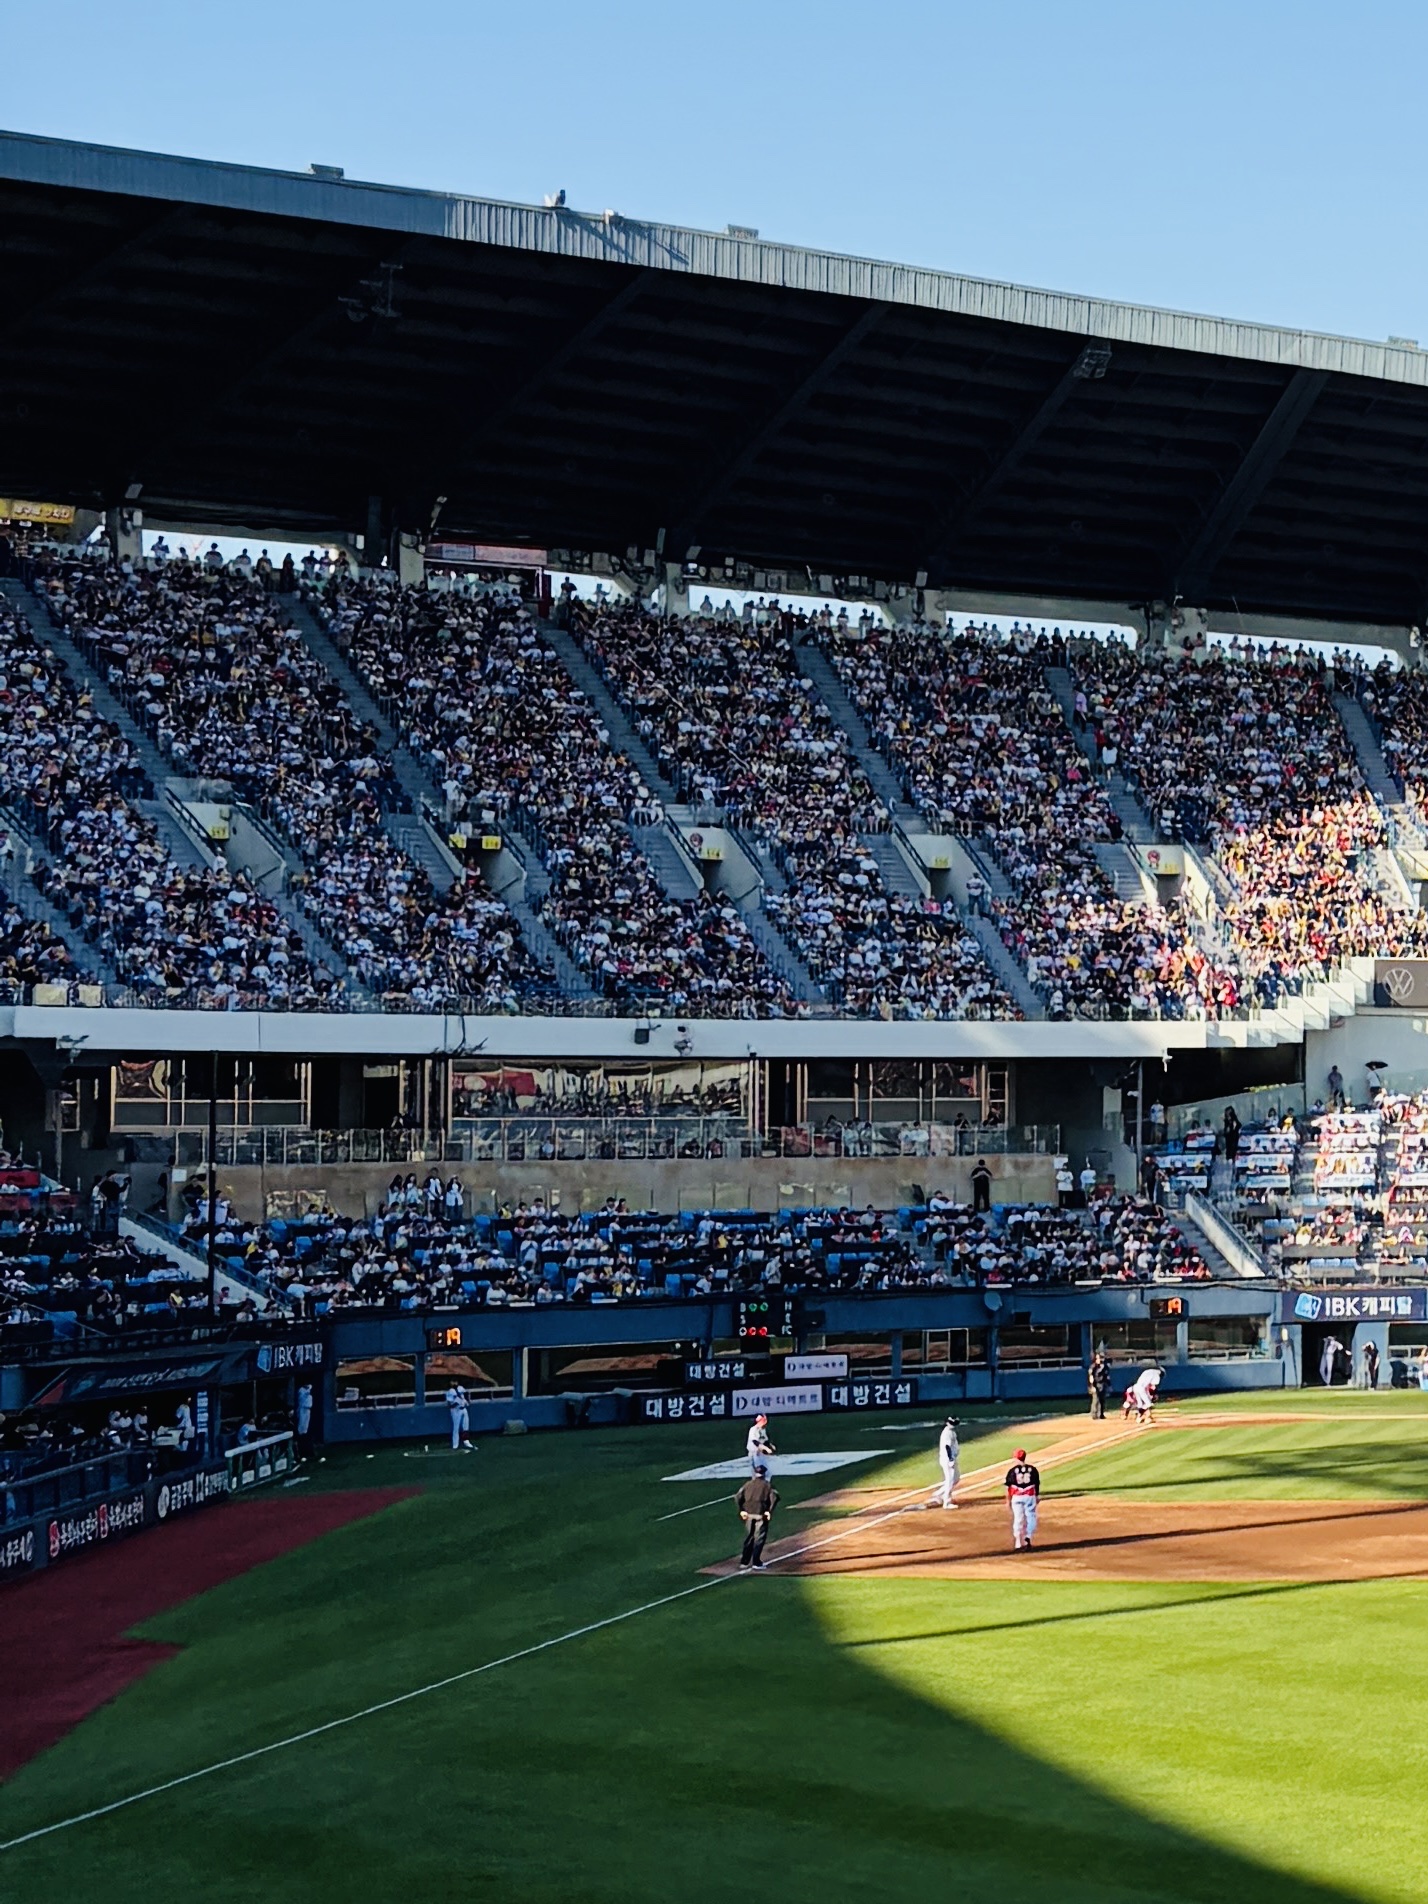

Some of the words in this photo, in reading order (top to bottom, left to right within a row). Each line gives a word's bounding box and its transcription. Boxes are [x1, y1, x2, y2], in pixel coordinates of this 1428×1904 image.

[784, 1301, 792, 1311] H
[645, 1393, 726, 1419] 대방건설
[831, 1382, 912, 1407] 대방건설
